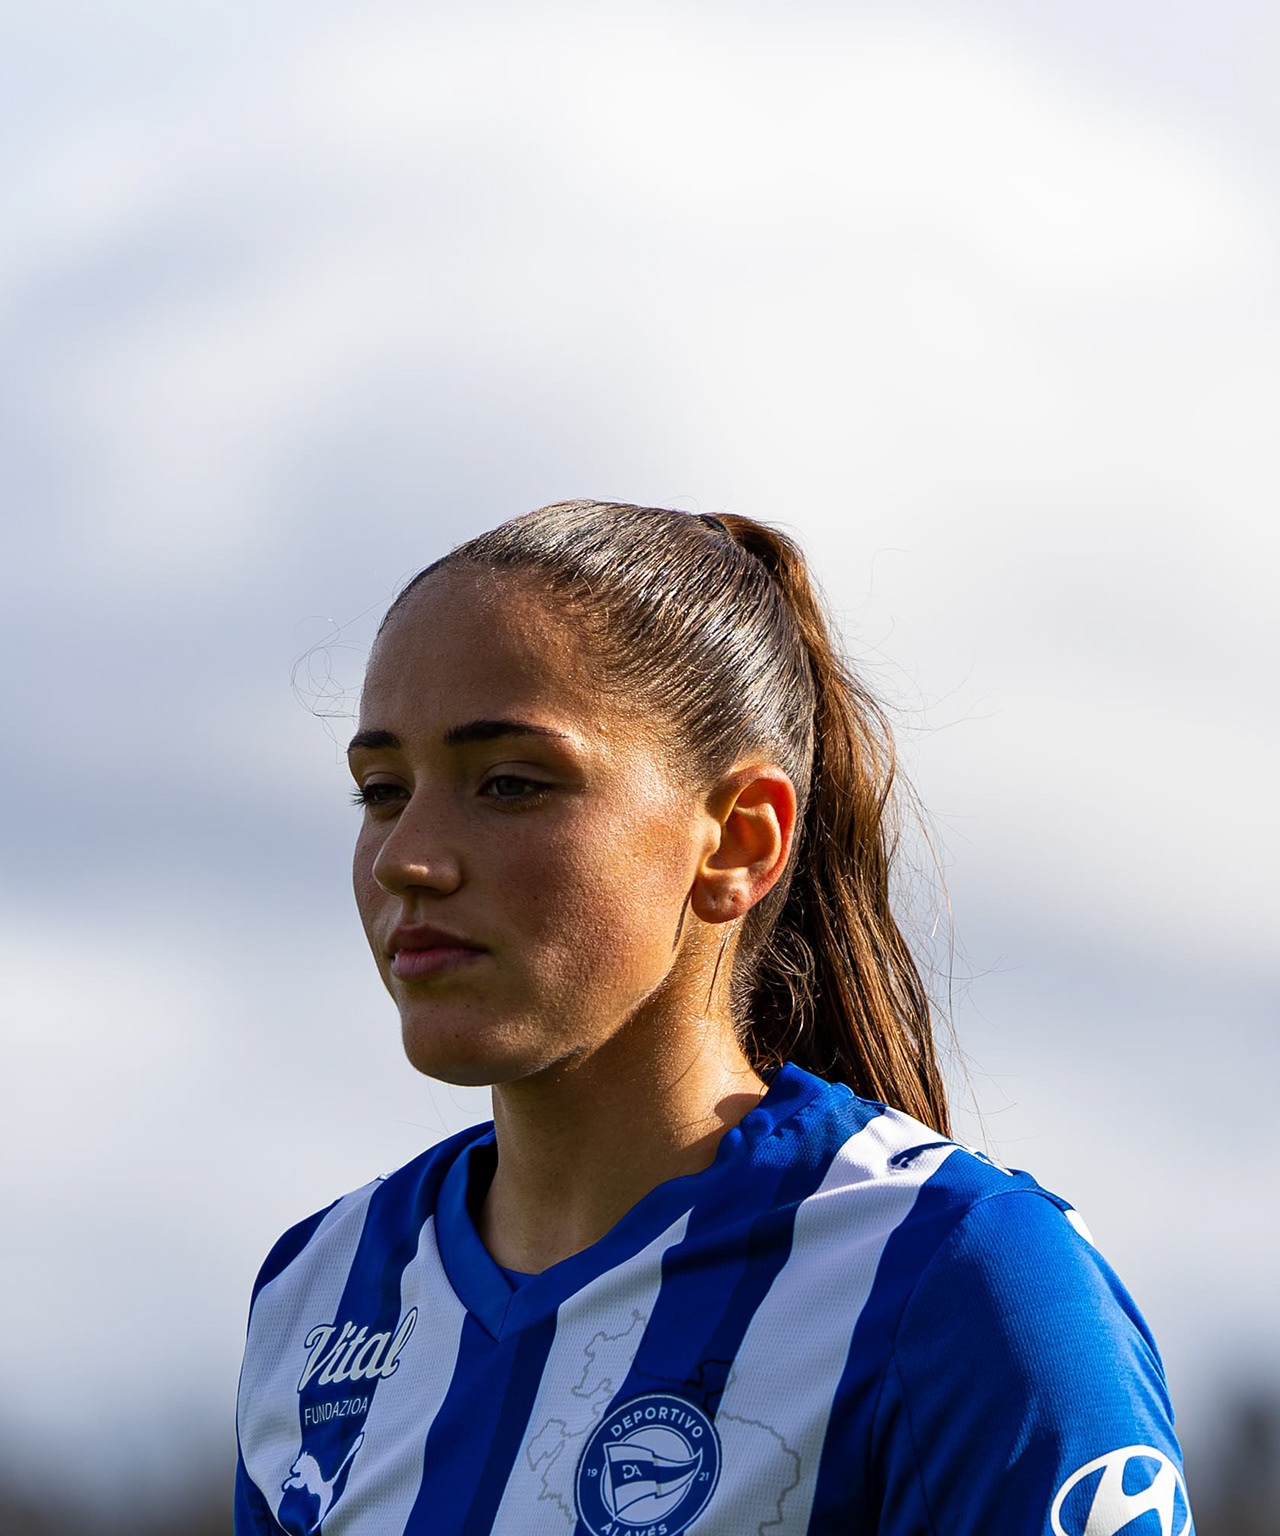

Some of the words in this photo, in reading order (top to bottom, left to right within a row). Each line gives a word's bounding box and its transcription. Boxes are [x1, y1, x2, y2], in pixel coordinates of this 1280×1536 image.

[297, 1306, 417, 1393] Vital
[304, 1396, 368, 1426] FUNDAZIOA
[610, 1406, 704, 1438] DEPORTIVO
[587, 1468, 598, 1478] 19
[698, 1471, 710, 1481] 21
